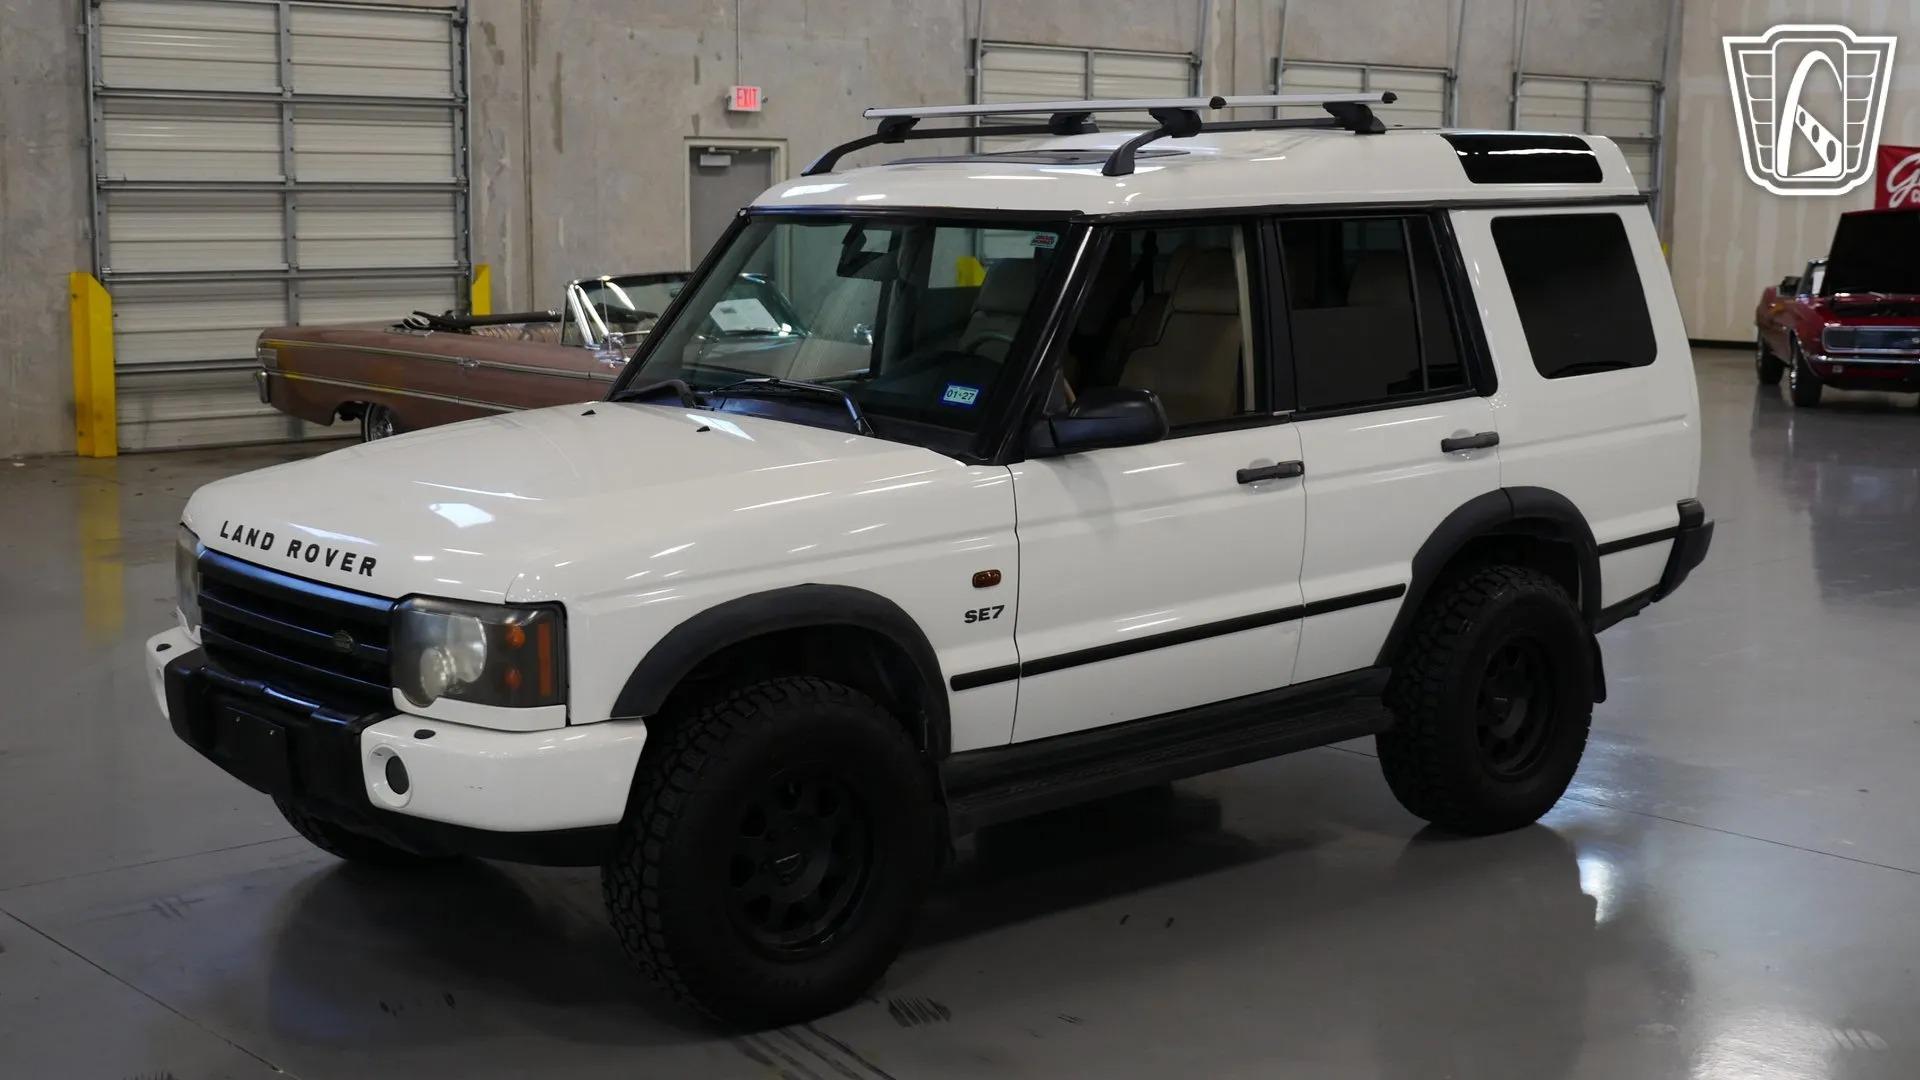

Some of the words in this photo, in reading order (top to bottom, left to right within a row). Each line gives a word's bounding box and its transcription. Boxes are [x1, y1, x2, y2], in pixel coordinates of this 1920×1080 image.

[736, 87, 758, 108] EXIT
[219, 520, 275, 551] LAND
[286, 539, 377, 577] ROVER
[964, 604, 1005, 624] SE7
